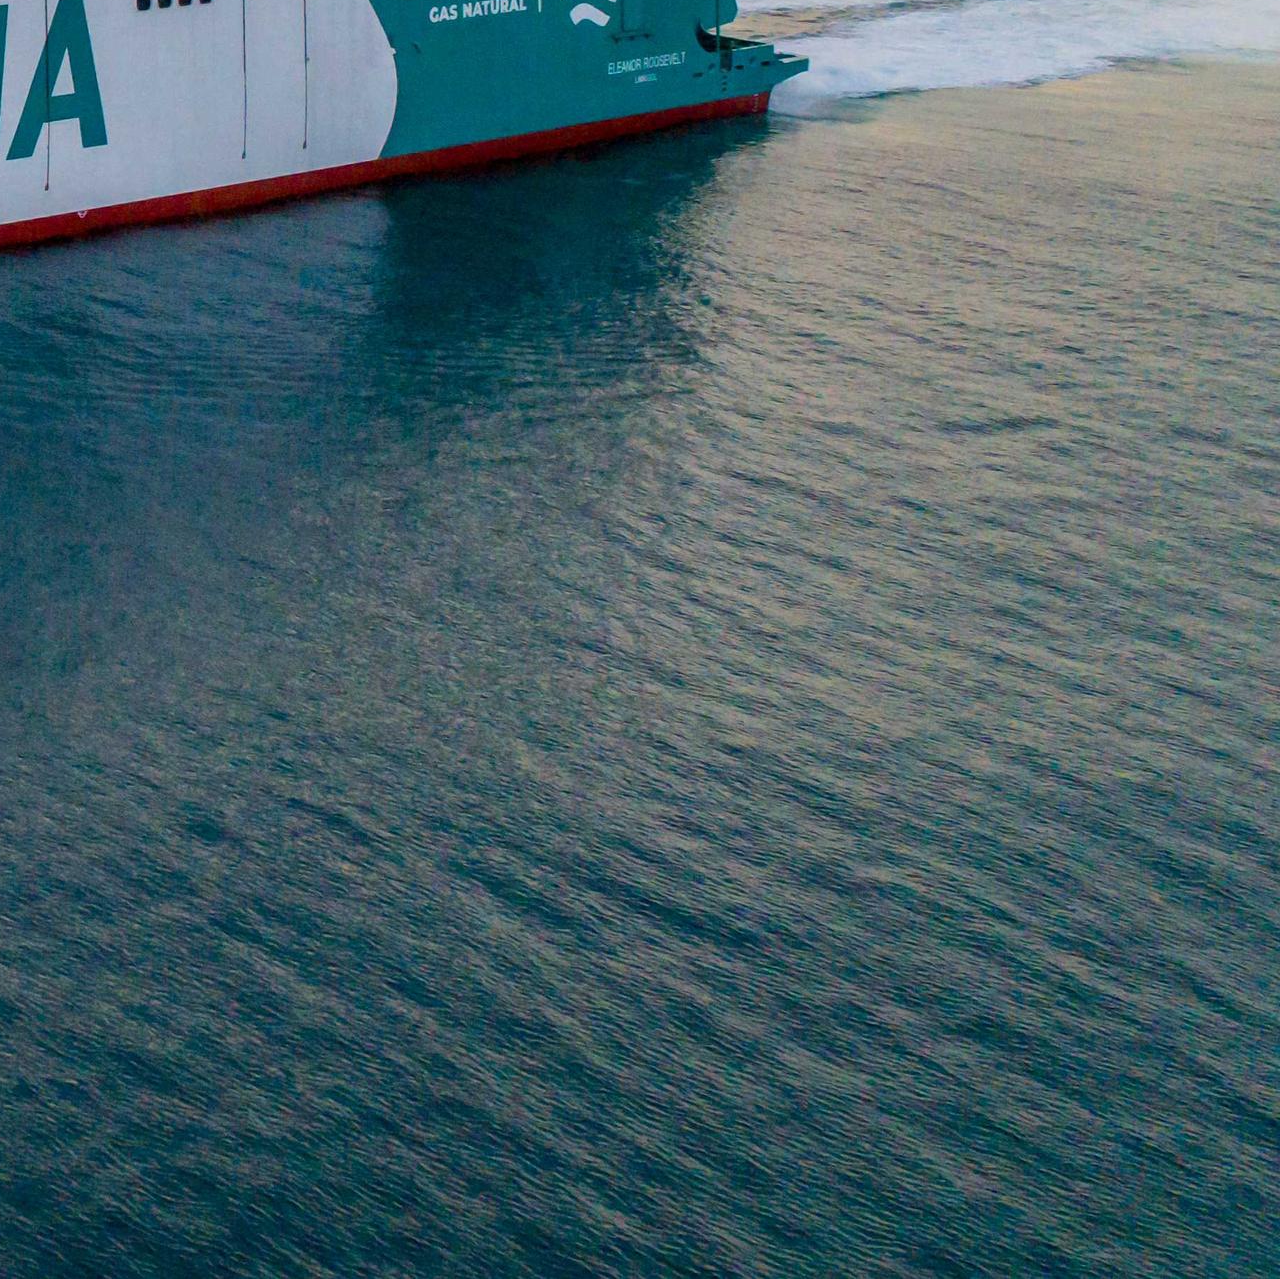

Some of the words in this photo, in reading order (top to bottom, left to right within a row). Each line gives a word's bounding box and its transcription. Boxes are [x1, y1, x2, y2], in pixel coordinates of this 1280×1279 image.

[429, 4, 459, 23] GAS
[607, 58, 642, 75] ELEANOR
[643, 51, 686, 69] ROOSEVELT
